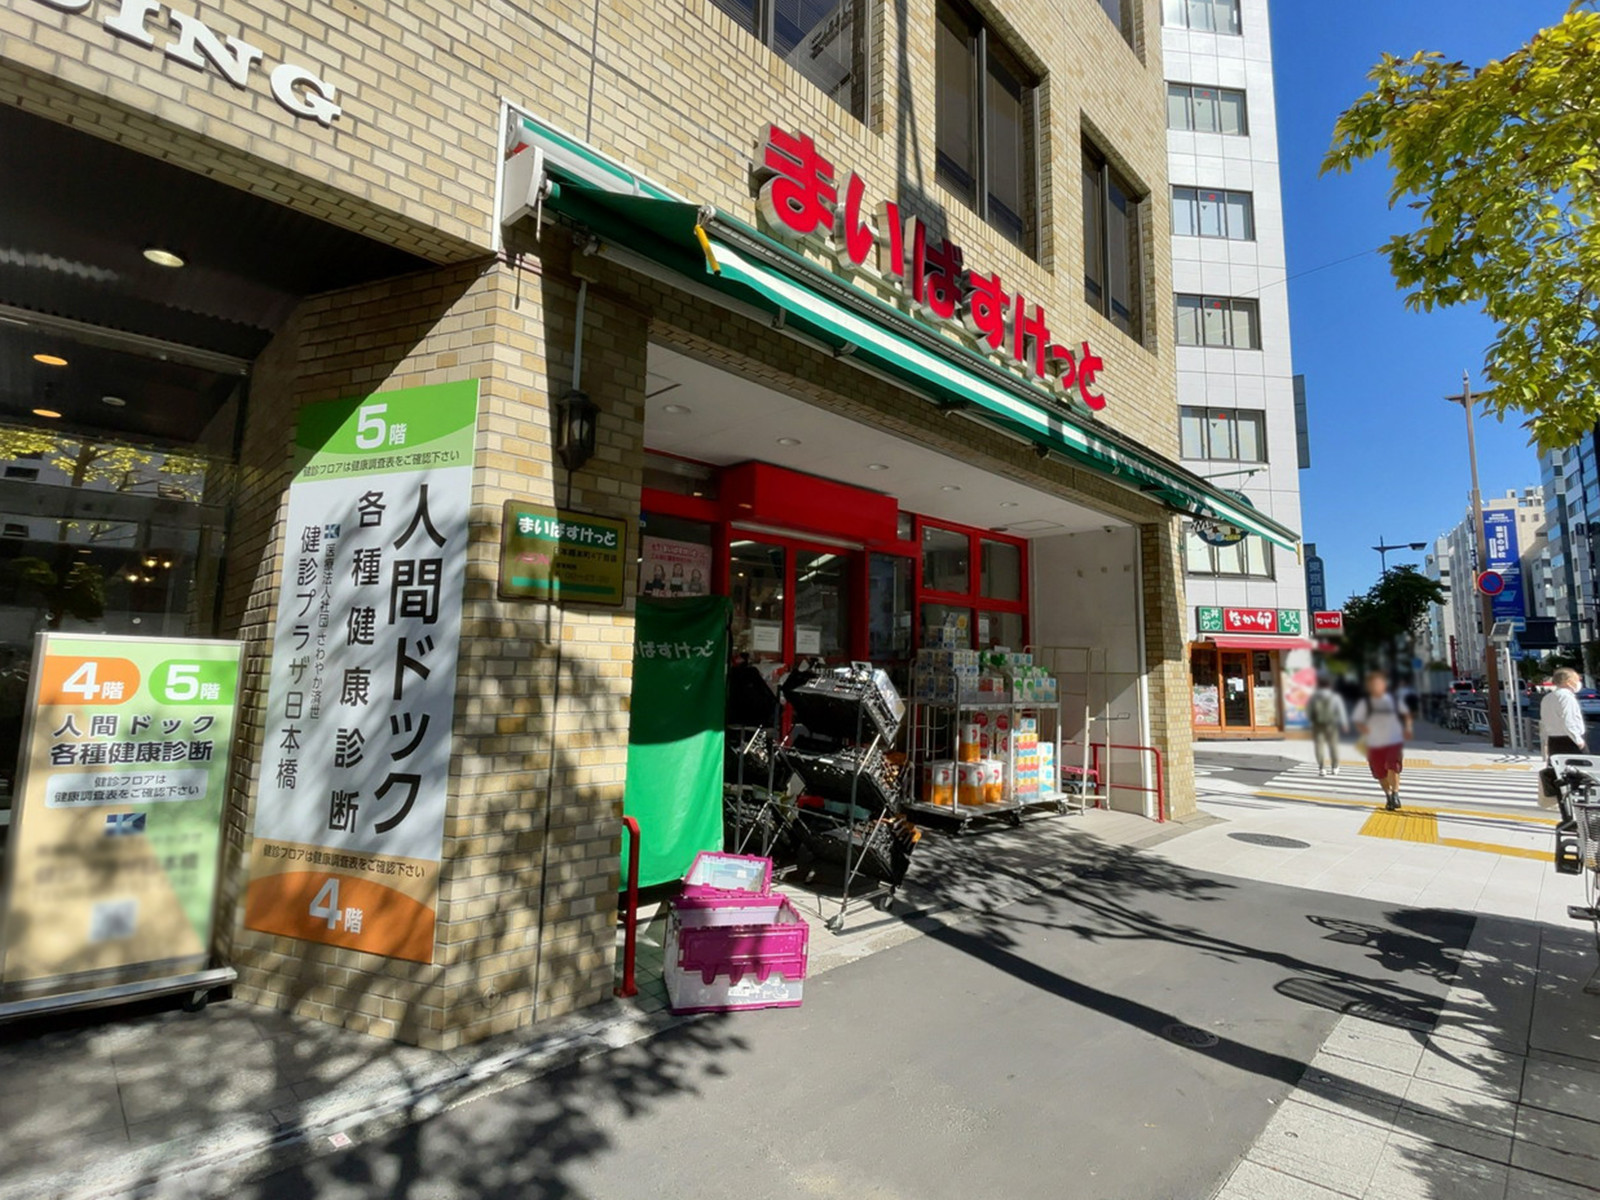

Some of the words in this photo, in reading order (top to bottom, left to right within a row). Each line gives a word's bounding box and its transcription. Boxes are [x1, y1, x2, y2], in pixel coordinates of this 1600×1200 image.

[22, 0, 342, 129] ING
[757, 123, 1107, 411] まいばすけっと
[355, 402, 407, 449] 5階
[302, 450, 460, 477] 健診フロアは健康調査表をご確認下さい
[518, 516, 616, 546] まいばすけっと
[1308, 561, 1323, 610] 東京信用
[1229, 610, 1272, 629] なか卯
[276, 525, 321, 789] 健診プラザ日本橋
[328, 489, 387, 834] 各種健康診断
[374, 483, 447, 834] 人間ドック
[62, 661, 125, 700] 4階
[165, 664, 220, 701] 5階
[53, 714, 215, 737] 人間ドック
[51, 740, 213, 766] 各種健康診断
[54, 785, 200, 804] 健康調査表をご確認下さい
[94, 774, 167, 788] 健診フロアは
[263, 844, 425, 878] 健診フロアは健康調査表をご確認下さい
[308, 878, 363, 934] 4階
